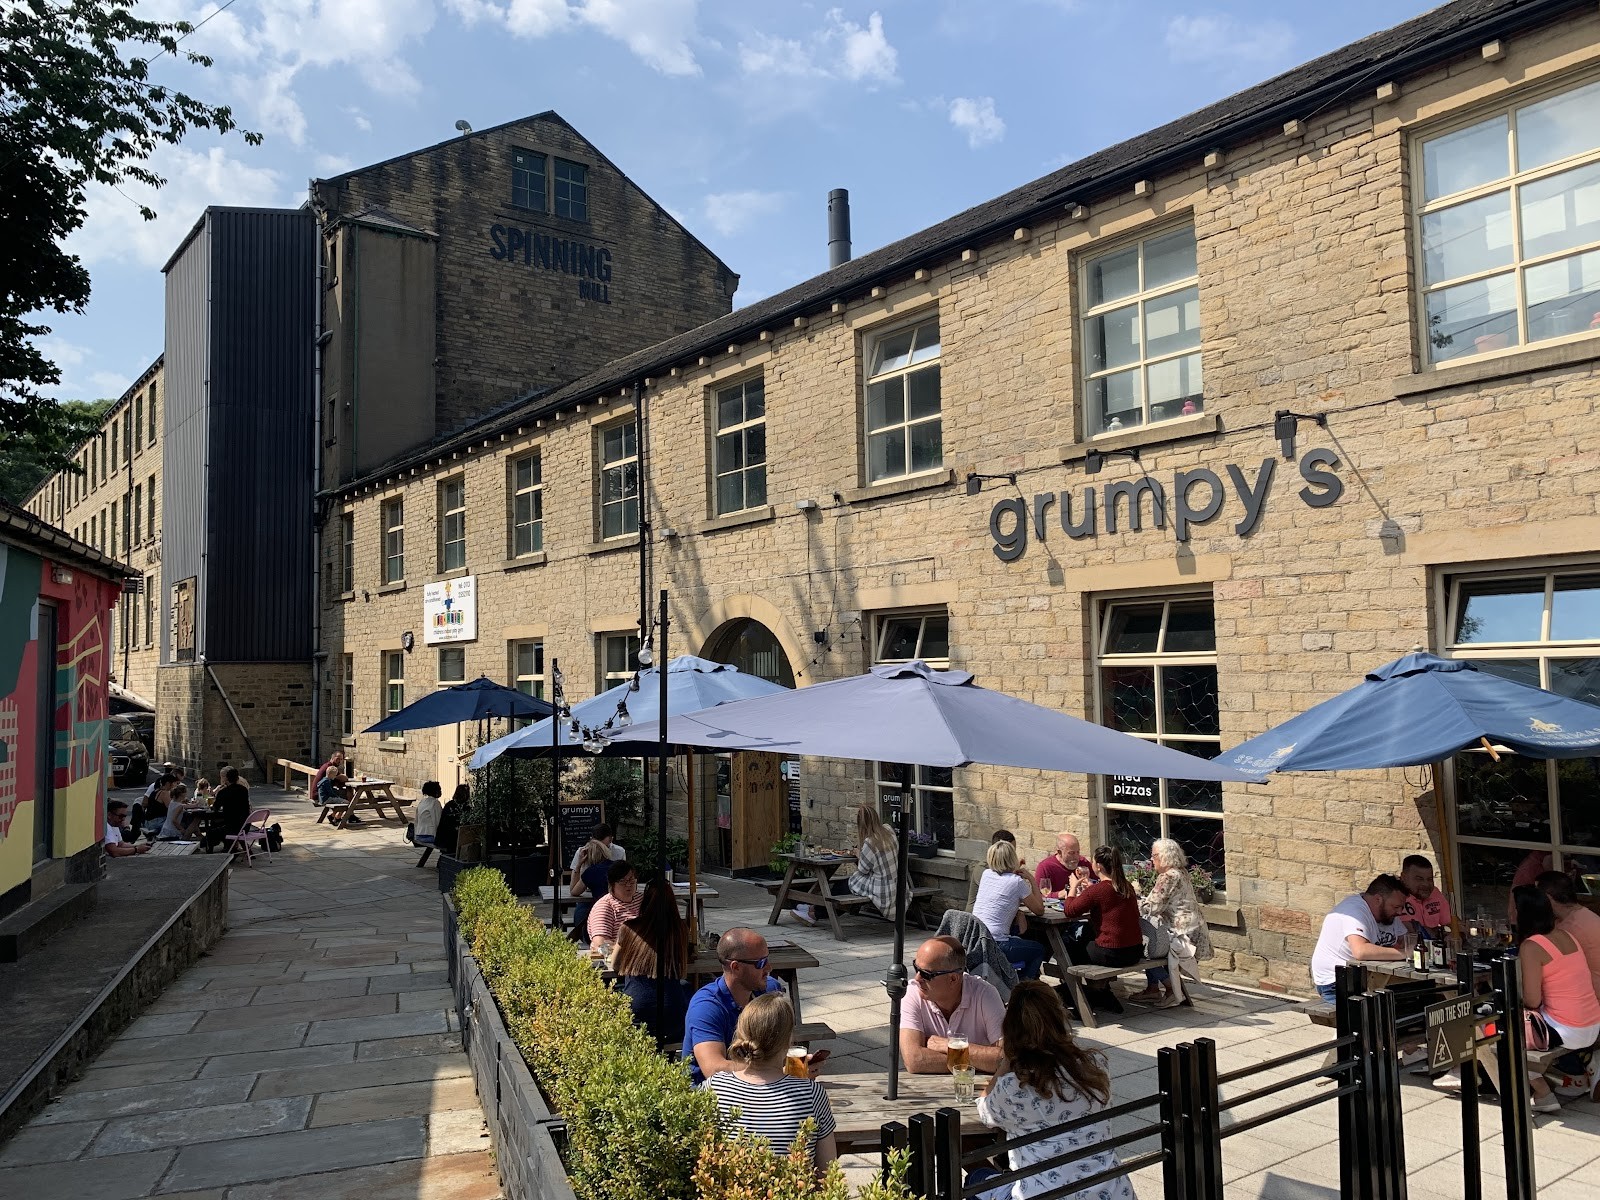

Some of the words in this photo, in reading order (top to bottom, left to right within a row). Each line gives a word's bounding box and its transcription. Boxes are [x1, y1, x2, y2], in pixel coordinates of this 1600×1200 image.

[490, 224, 611, 282] SPINNING
[579, 279, 611, 304] MILL
[989, 436, 1343, 561] grumpy's
[883, 794, 914, 804] grums
[1114, 783, 1152, 797] pizzas
[562, 806, 600, 815] grumpy's
[1429, 1009, 1445, 1027] MIND
[1445, 1004, 1457, 1021] THE
[1457, 1001, 1471, 1018] STEP
